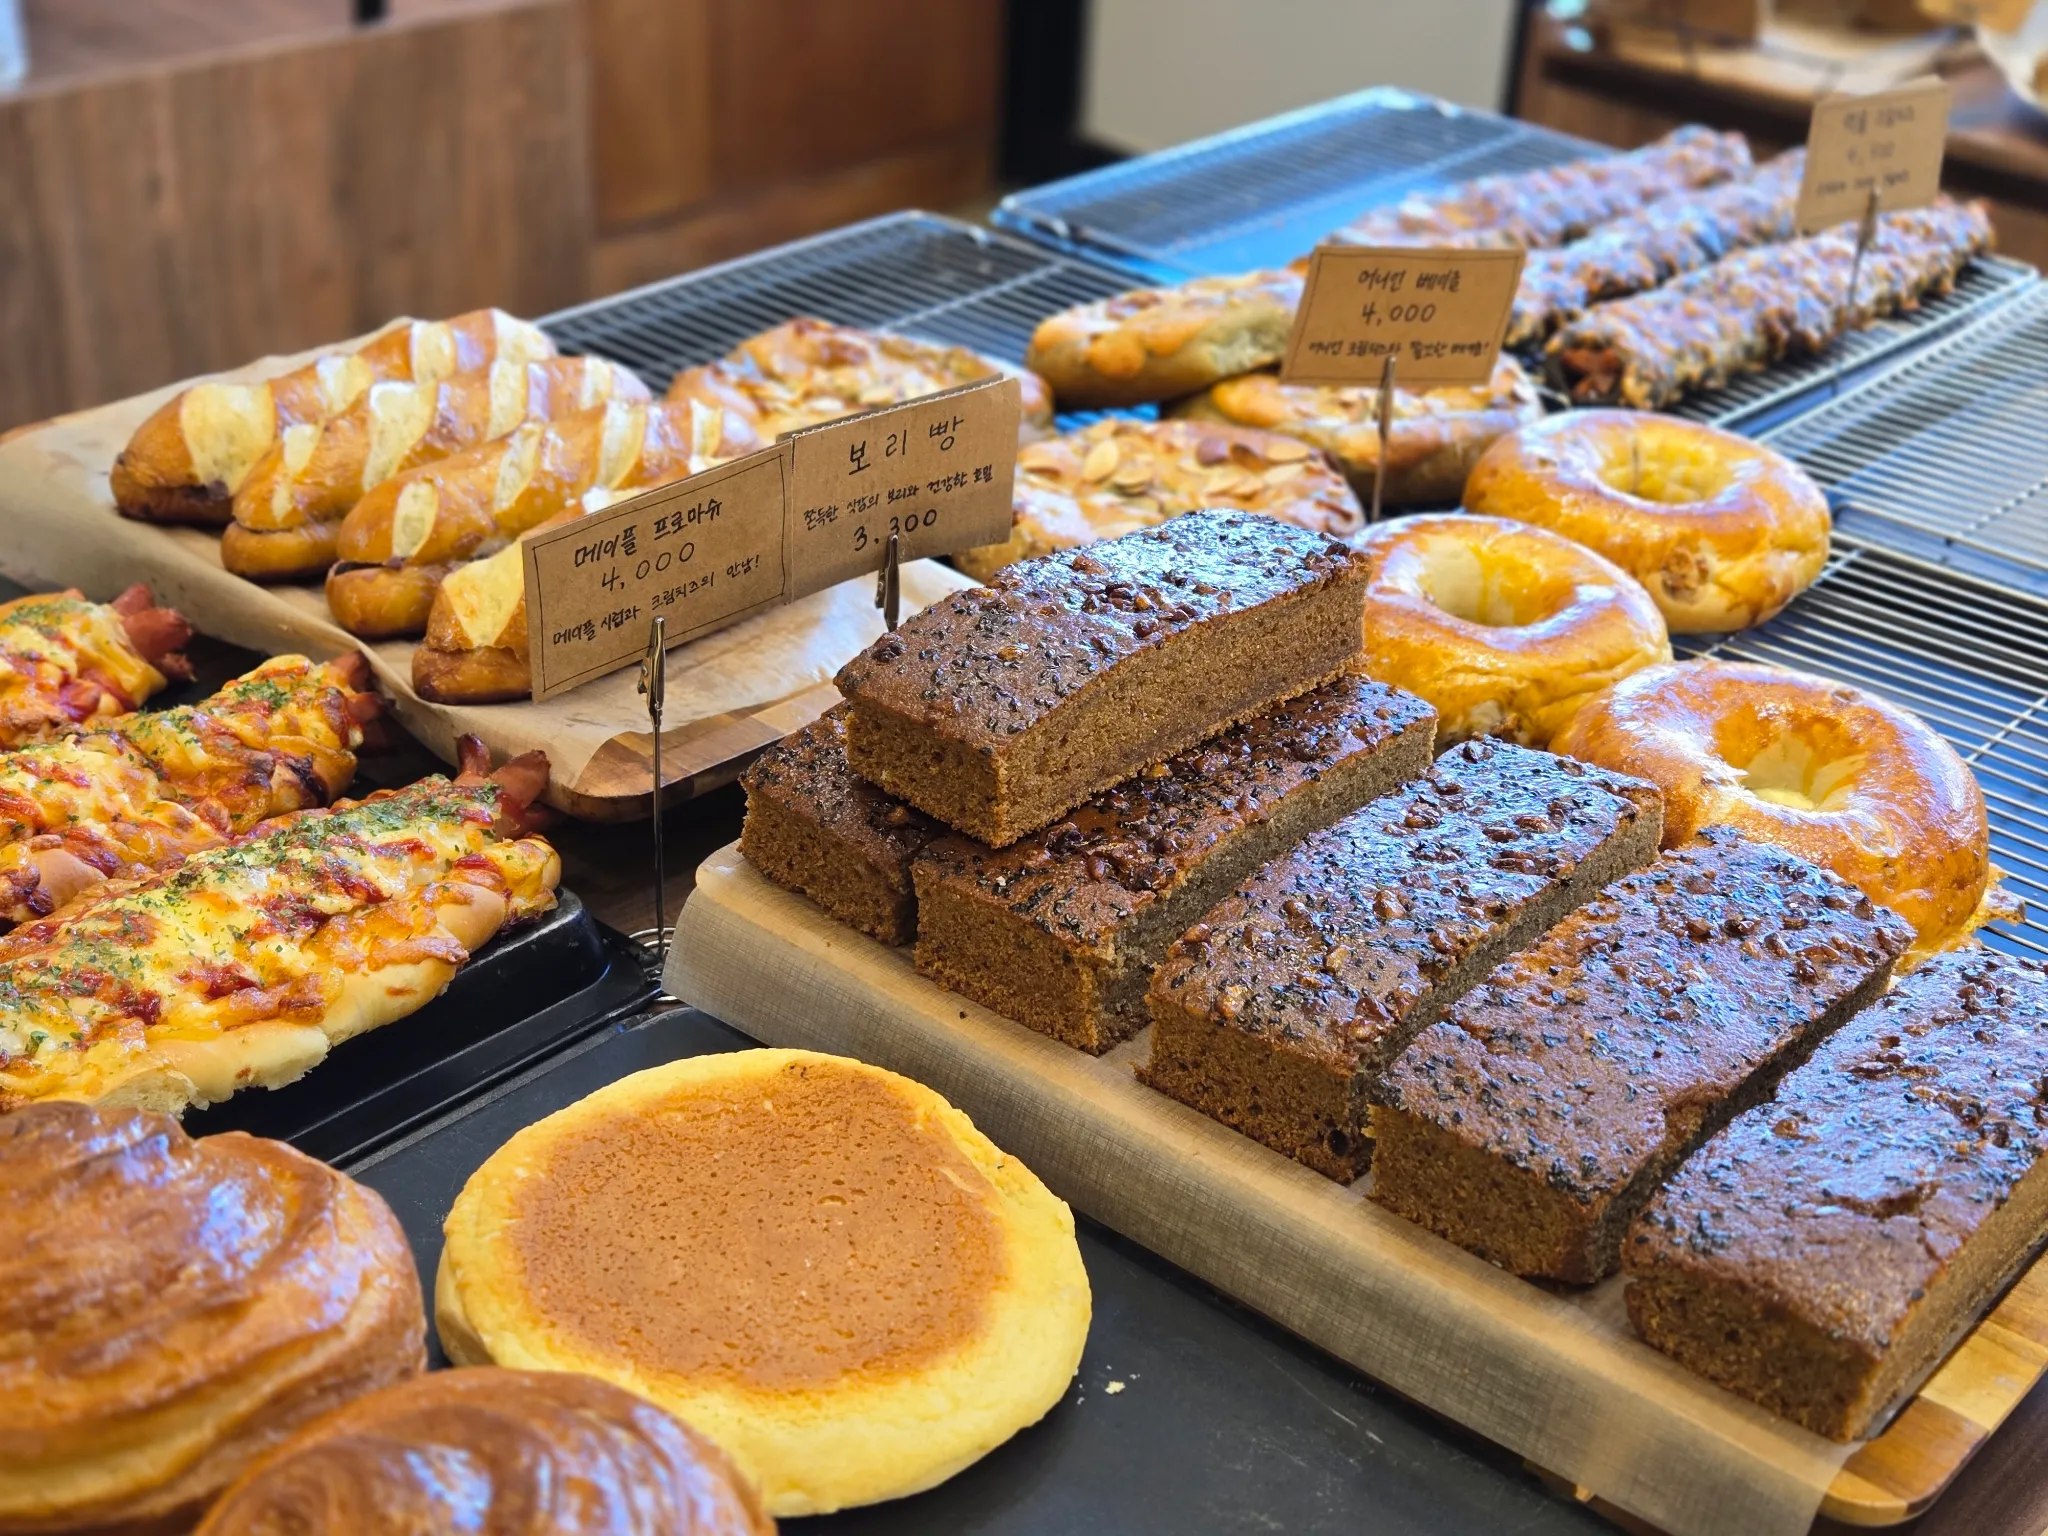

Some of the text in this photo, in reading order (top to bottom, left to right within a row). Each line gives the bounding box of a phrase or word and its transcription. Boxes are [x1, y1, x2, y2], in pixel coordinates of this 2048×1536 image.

[1358, 267, 1461, 293] 어니언 베이글
[1361, 301, 1436, 327] 4,000
[803, 504, 839, 531] 쫀득한
[887, 484, 920, 505] 보리와
[926, 470, 968, 495] 건강한
[972, 463, 994, 484] 호밀
[573, 524, 638, 568] 메이플
[600, 542, 695, 592] 4,000
[552, 554, 761, 646] 메이플 시럽과 크림치즈의 만남!
